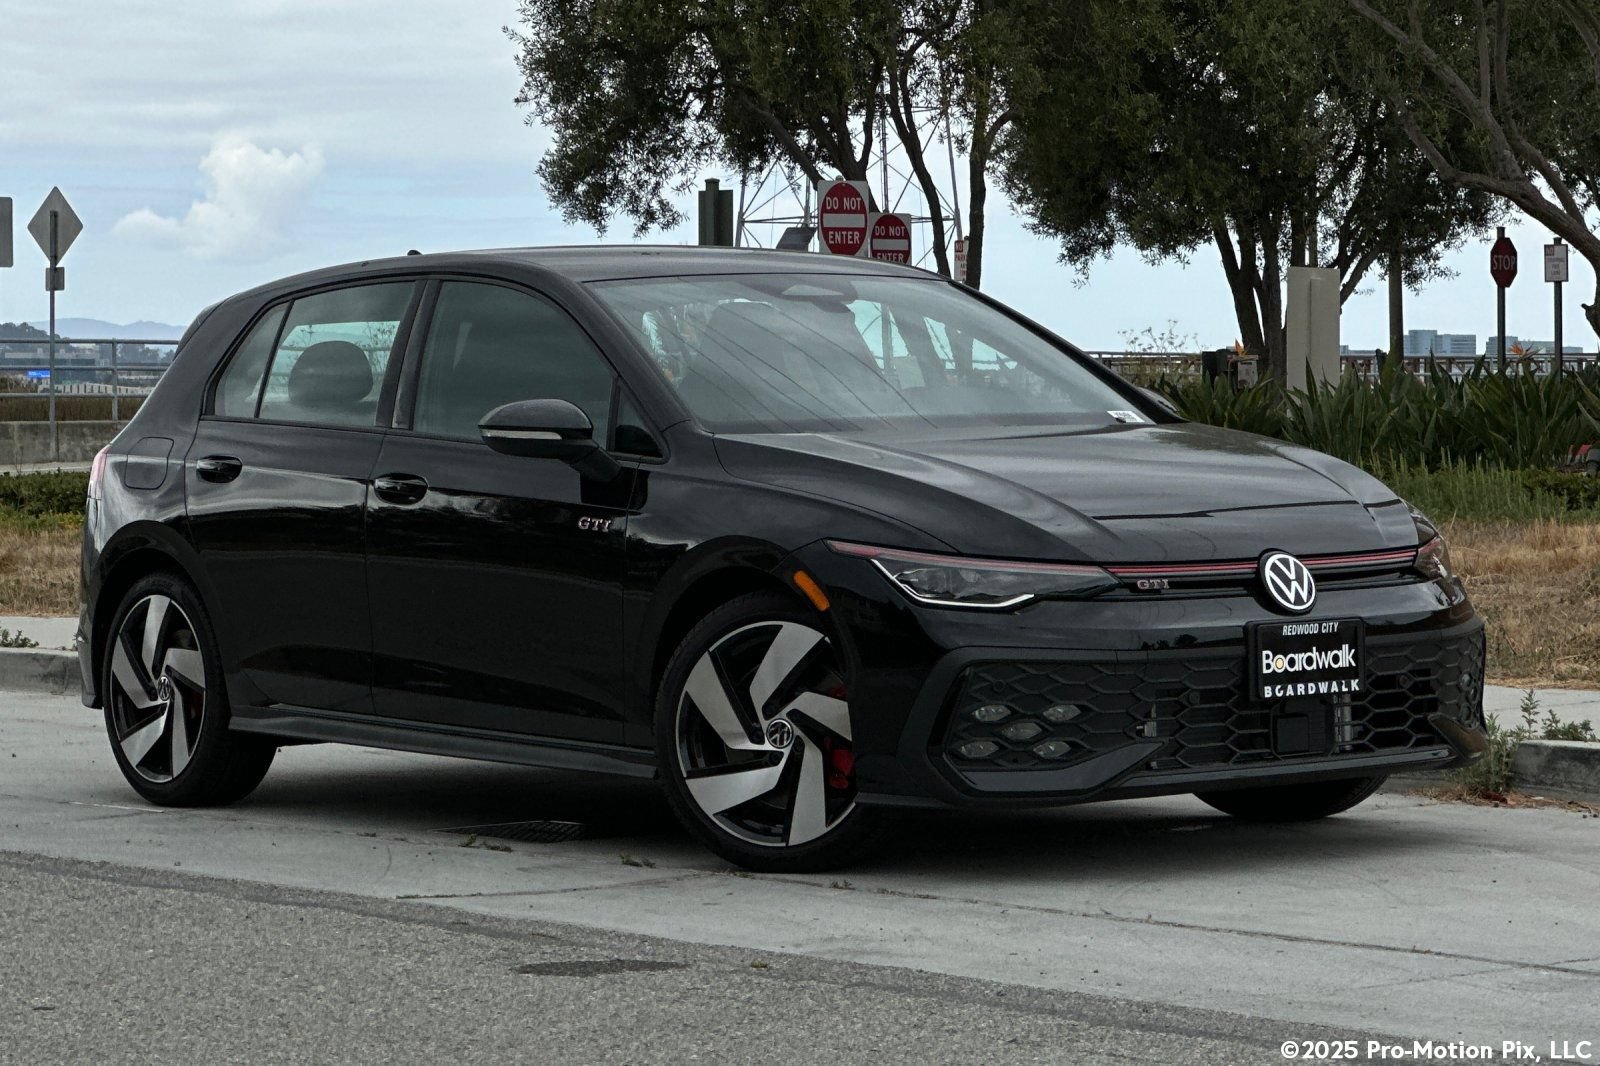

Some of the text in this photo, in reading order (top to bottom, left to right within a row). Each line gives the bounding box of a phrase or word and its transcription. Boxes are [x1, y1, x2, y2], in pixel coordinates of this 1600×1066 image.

[826, 197, 861, 210] DO NOT
[828, 231, 860, 244] ENTER
[875, 226, 905, 236] DO NOT
[1493, 255, 1515, 270] STOP
[578, 516, 612, 533] GTI
[1137, 578, 1170, 590] GTI
[1282, 622, 1339, 636] REDWOOD CITY
[1262, 643, 1357, 674] Boardwalk
[1264, 679, 1360, 698] BOARDWALK
